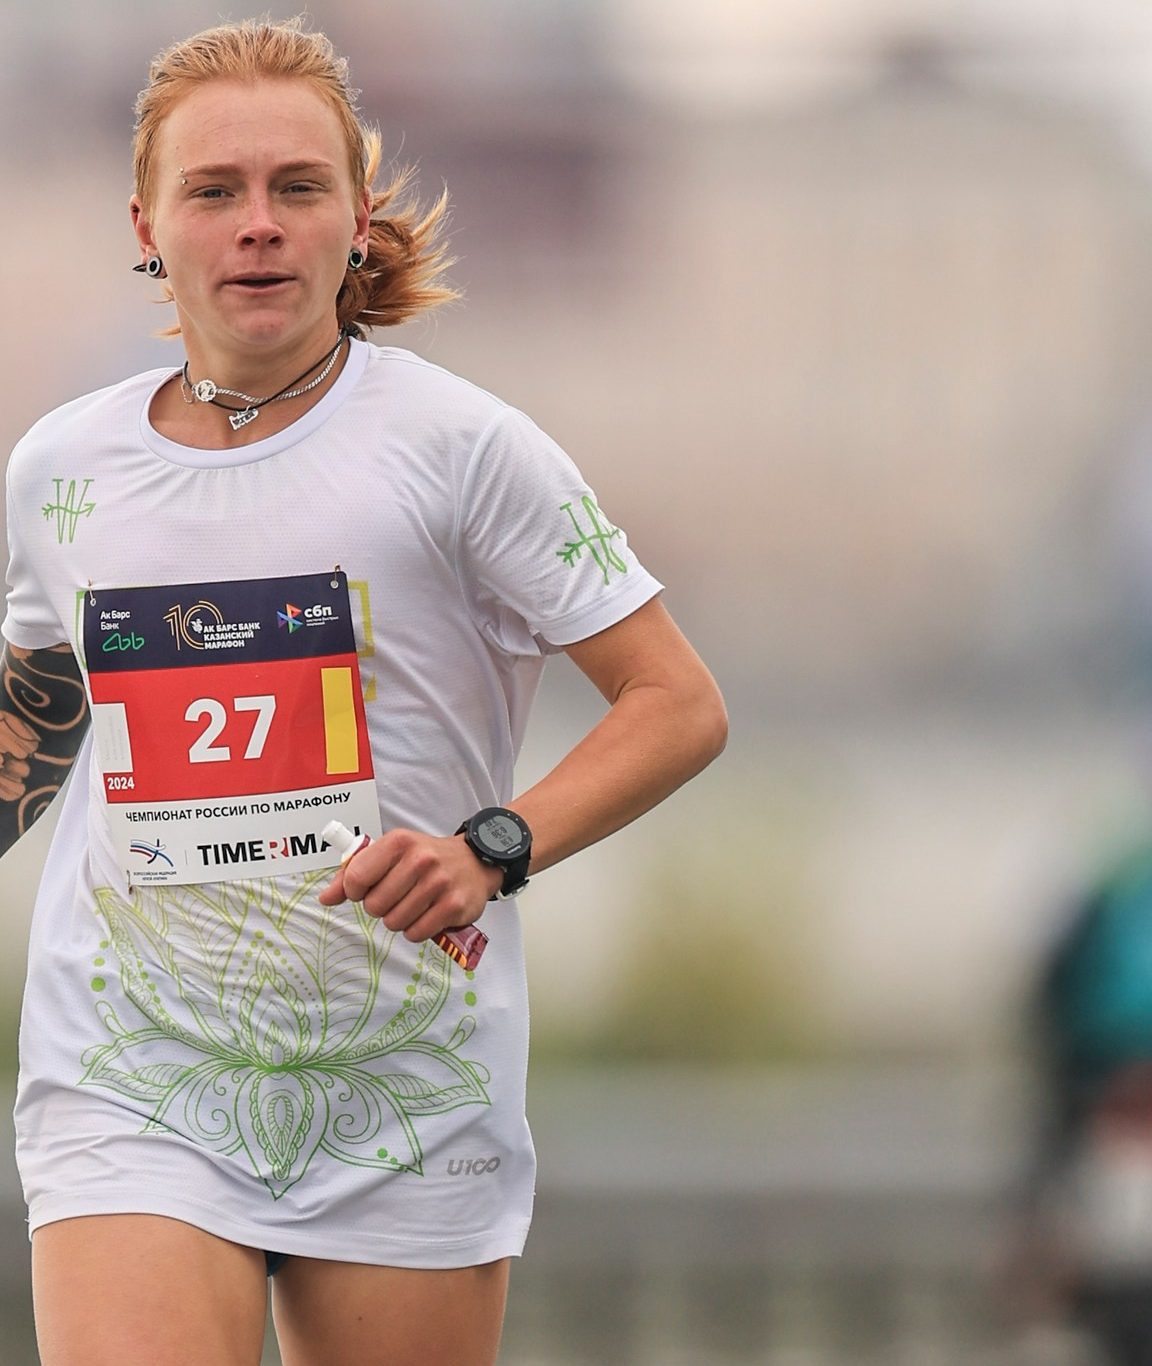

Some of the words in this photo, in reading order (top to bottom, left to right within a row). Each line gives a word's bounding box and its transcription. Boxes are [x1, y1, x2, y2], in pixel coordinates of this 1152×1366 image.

[100, 610, 111, 620] Ак
[112, 610, 131, 621] Барс
[304, 604, 333, 618] сбп
[100, 621, 120, 631] Банк
[203, 625, 215, 633] АК
[216, 623, 238, 633] БАРС
[238, 622, 261, 631] БАНК
[204, 630, 254, 642] КАЗАНСКИЙ
[204, 640, 245, 650] МАРАФОН
[184, 694, 277, 764] 27
[107, 776, 135, 791] 2024
[125, 808, 193, 822] ЧЕМПИОНАТ
[195, 804, 248, 819] РОССИИ
[250, 802, 271, 815] ПО
[273, 791, 352, 812] МАРАФОНУ
